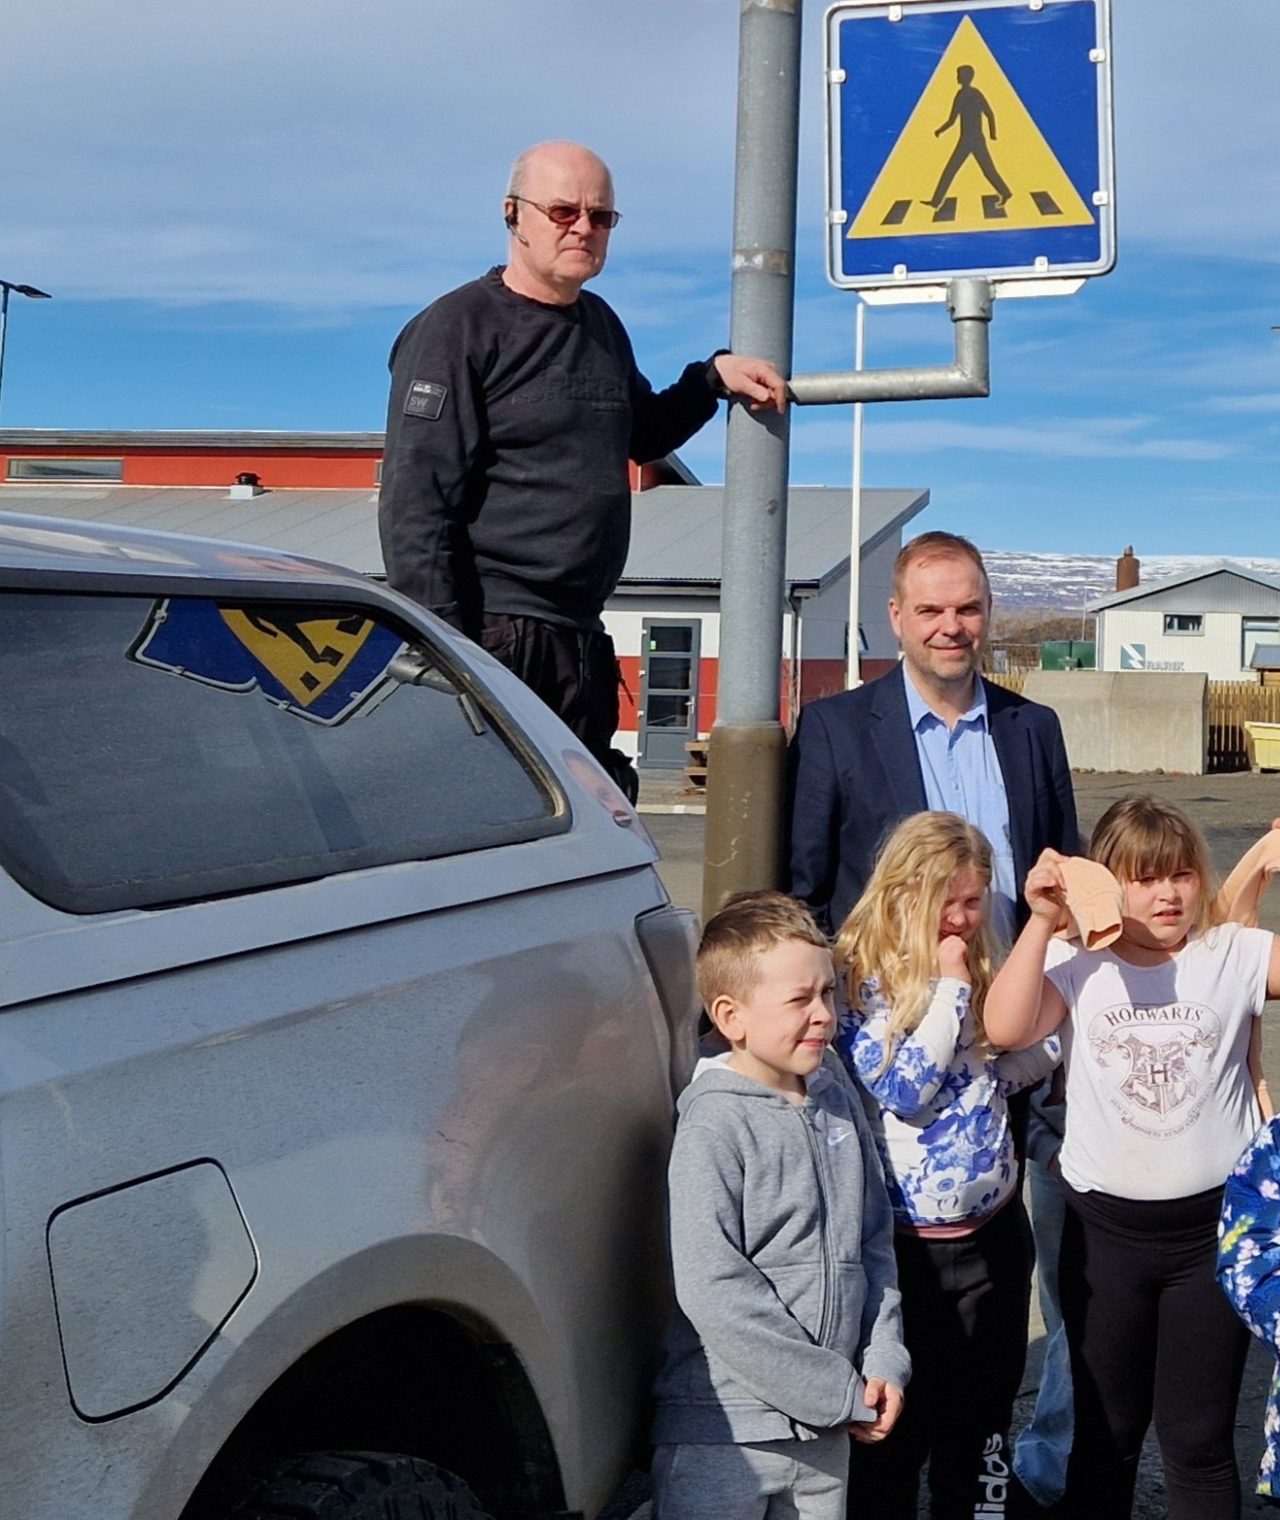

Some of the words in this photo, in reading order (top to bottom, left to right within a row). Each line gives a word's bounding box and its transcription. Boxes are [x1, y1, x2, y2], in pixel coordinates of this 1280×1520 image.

[1104, 1006, 1203, 1026] HOGWARTS
[1150, 1063, 1169, 1084] H
[974, 1433, 1009, 1520] idas
